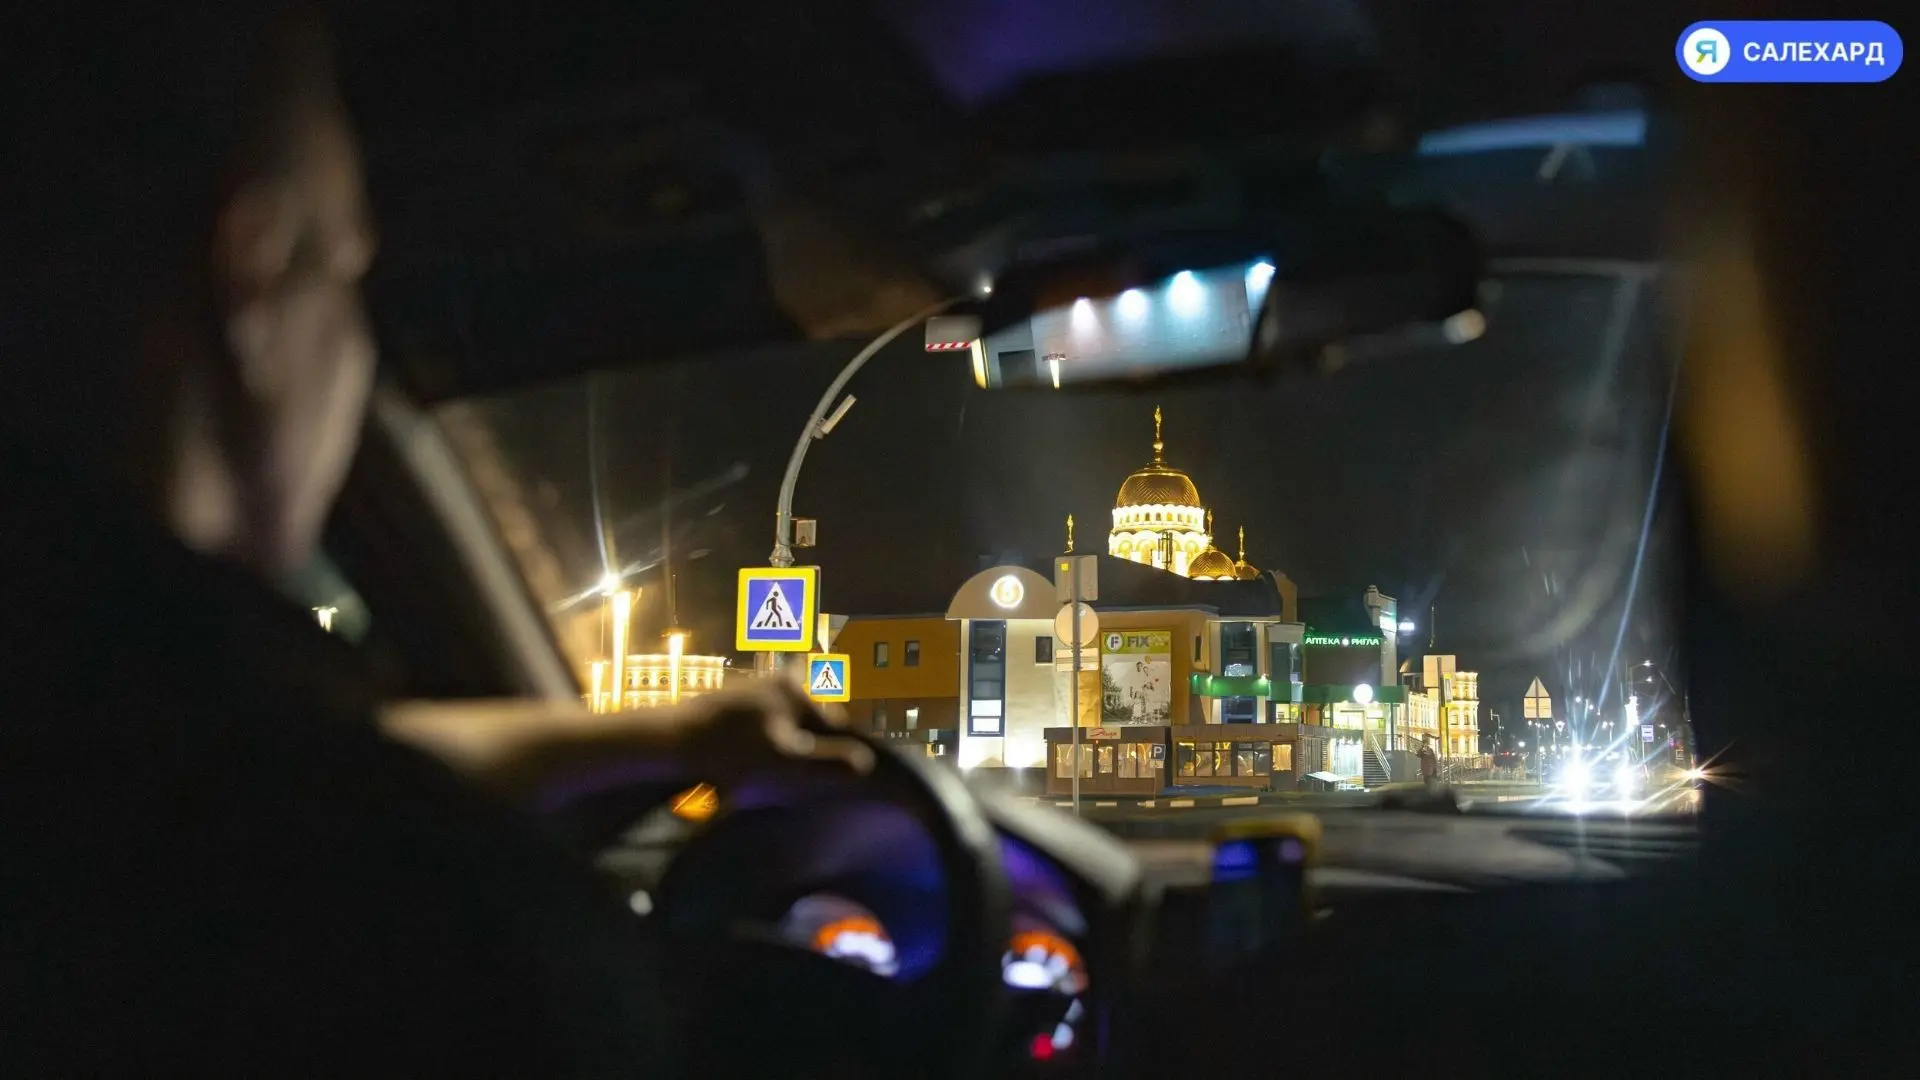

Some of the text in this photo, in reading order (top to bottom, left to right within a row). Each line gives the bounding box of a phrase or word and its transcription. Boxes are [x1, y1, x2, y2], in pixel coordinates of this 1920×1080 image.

[1127, 635, 1150, 648] FIX
[1305, 637, 1340, 645] АПТЕКА
[1153, 746, 1163, 758] P
